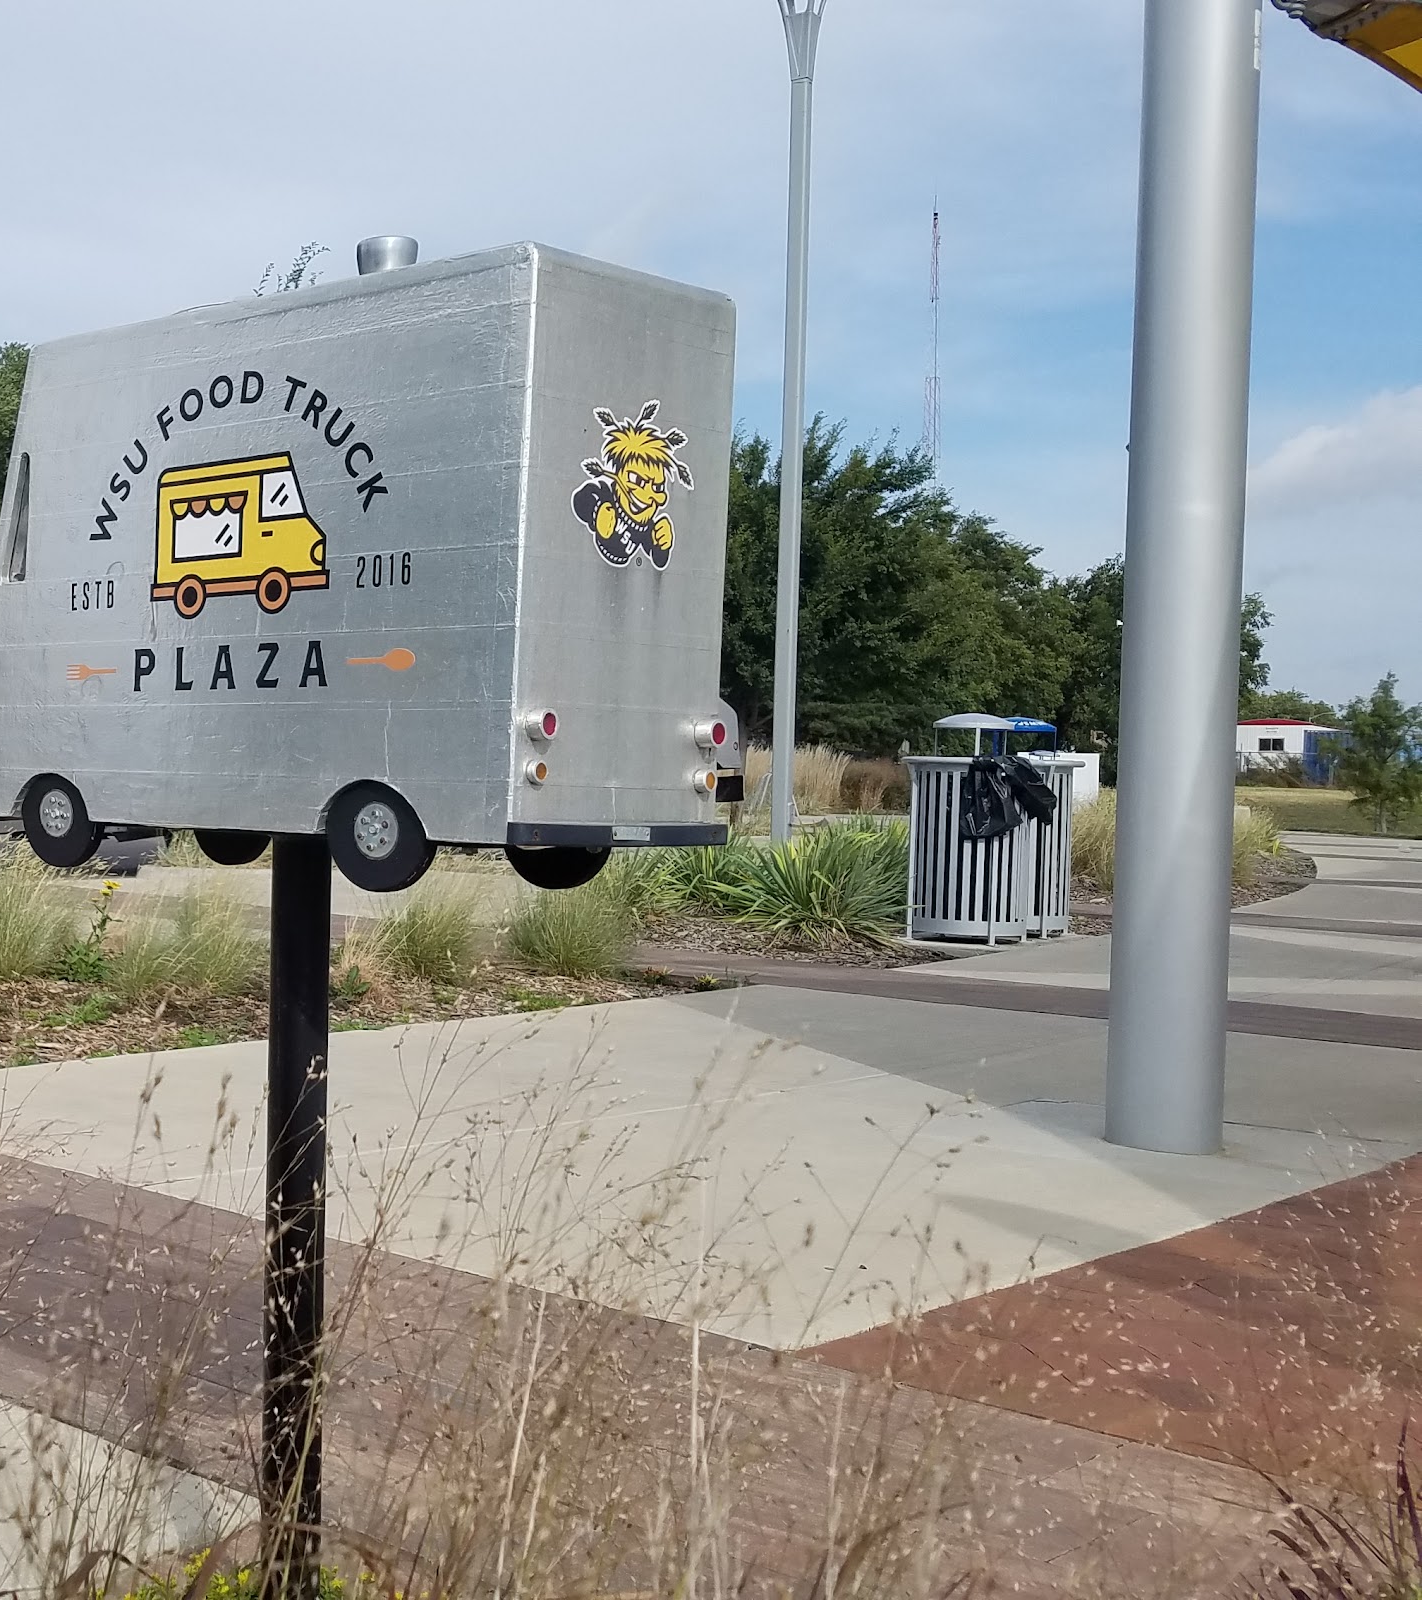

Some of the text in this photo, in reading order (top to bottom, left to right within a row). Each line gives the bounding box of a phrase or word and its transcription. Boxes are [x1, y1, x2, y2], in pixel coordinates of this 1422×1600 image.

[89, 370, 389, 541] WSU FOOD TRUCK
[614, 517, 636, 555] WSU
[70, 551, 412, 612] ESTB 2016
[132, 640, 329, 693] PLAZA
